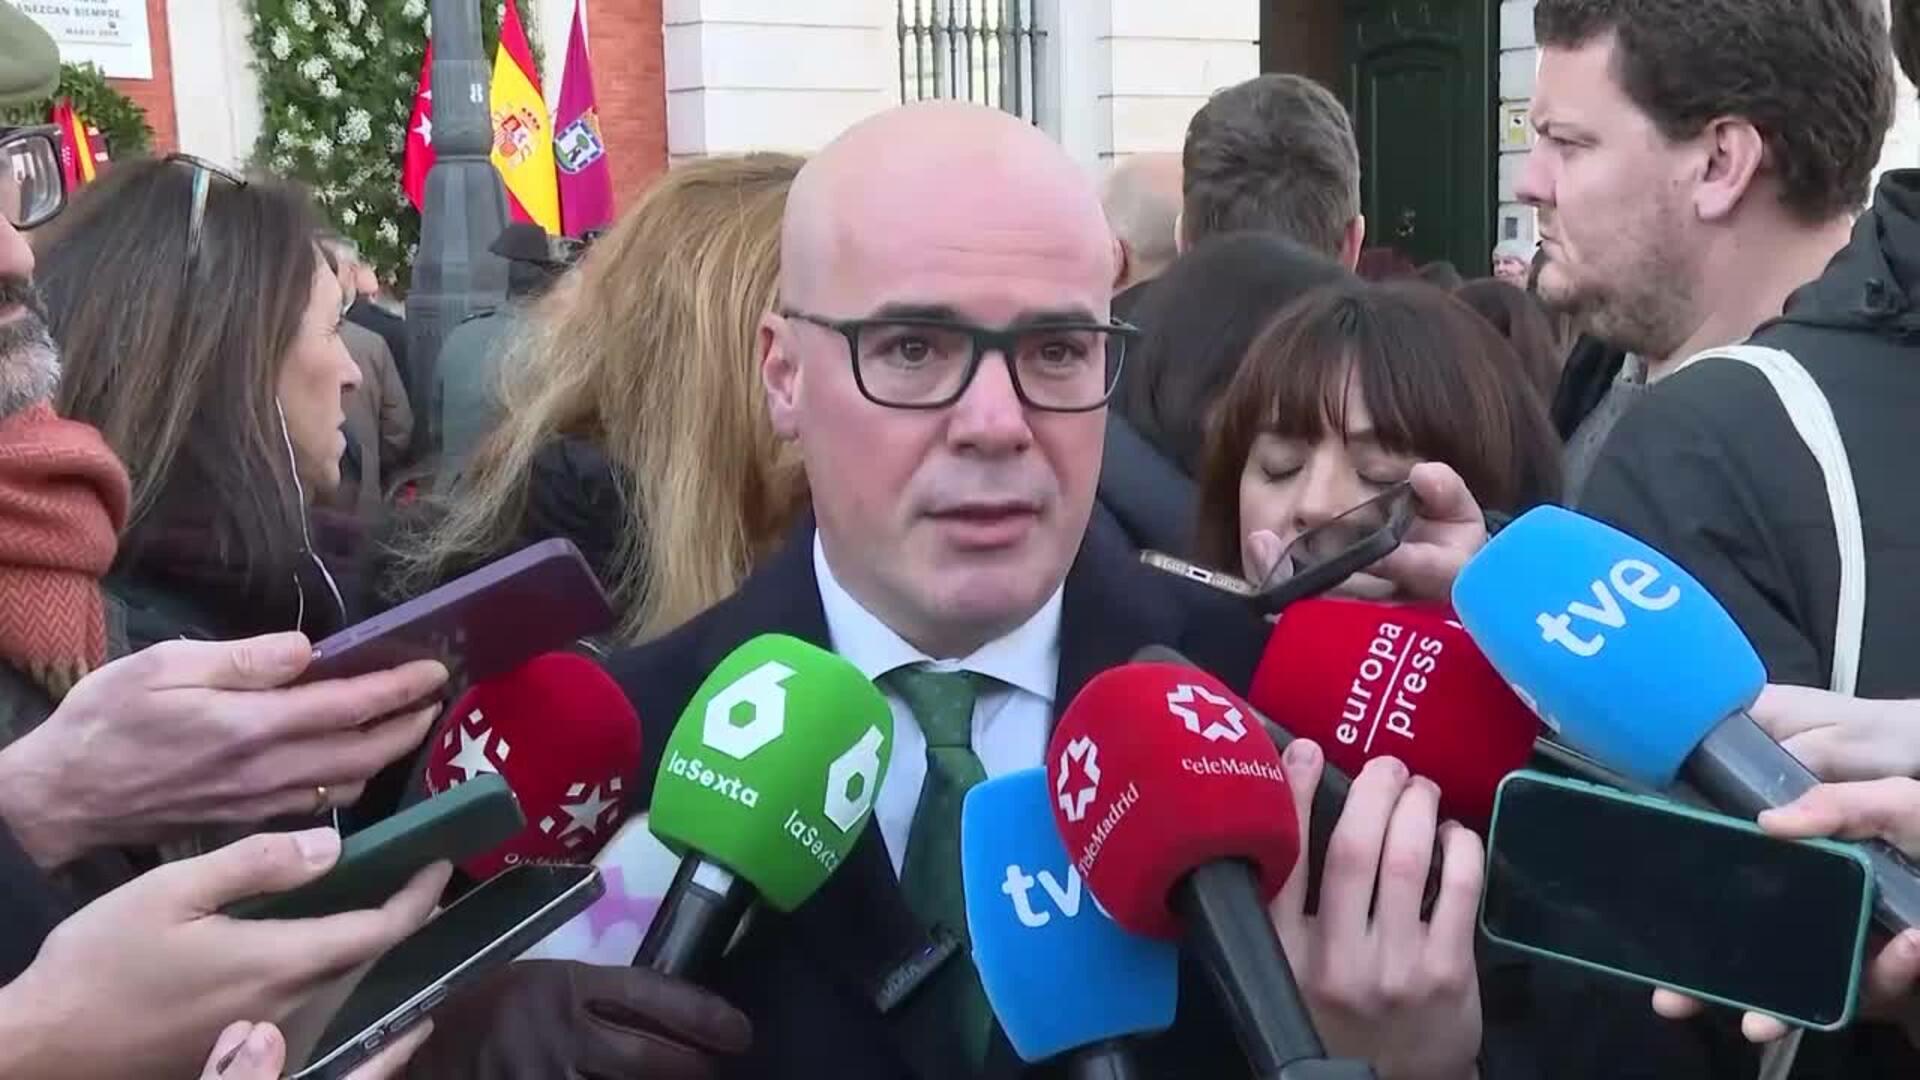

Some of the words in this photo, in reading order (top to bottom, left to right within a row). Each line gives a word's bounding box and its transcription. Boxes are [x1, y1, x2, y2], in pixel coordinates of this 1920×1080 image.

[1536, 559, 1681, 657] tve
[1336, 621, 1403, 745] europa
[1385, 636, 1443, 740] press
[667, 750, 760, 809] laSexta
[1002, 863, 1110, 928] tv
